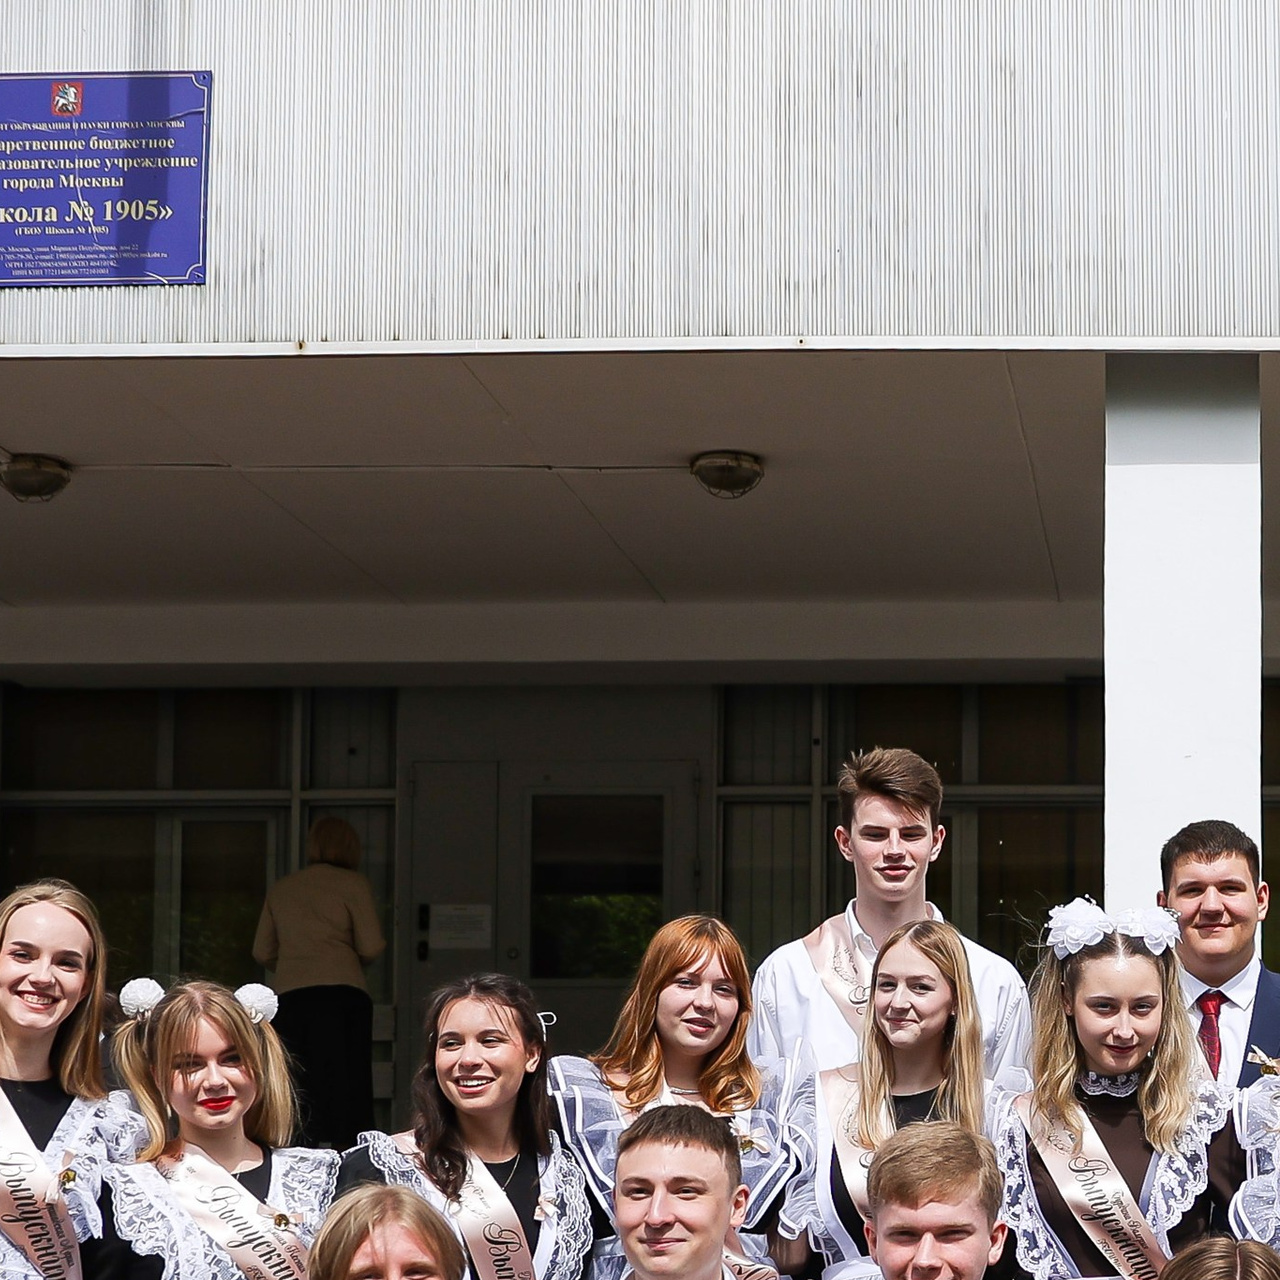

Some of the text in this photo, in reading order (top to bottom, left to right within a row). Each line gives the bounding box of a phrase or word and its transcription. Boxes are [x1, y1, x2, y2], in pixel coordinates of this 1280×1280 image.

[111, 120, 144, 129] ГОРОДА
[147, 120, 185, 129] МОСКВЫ
[89, 135, 175, 151] бюджетное
[104, 156, 198, 172] учреждение
[3, 174, 124, 192] города Москвы
[103, 199, 173, 221] 1905»
